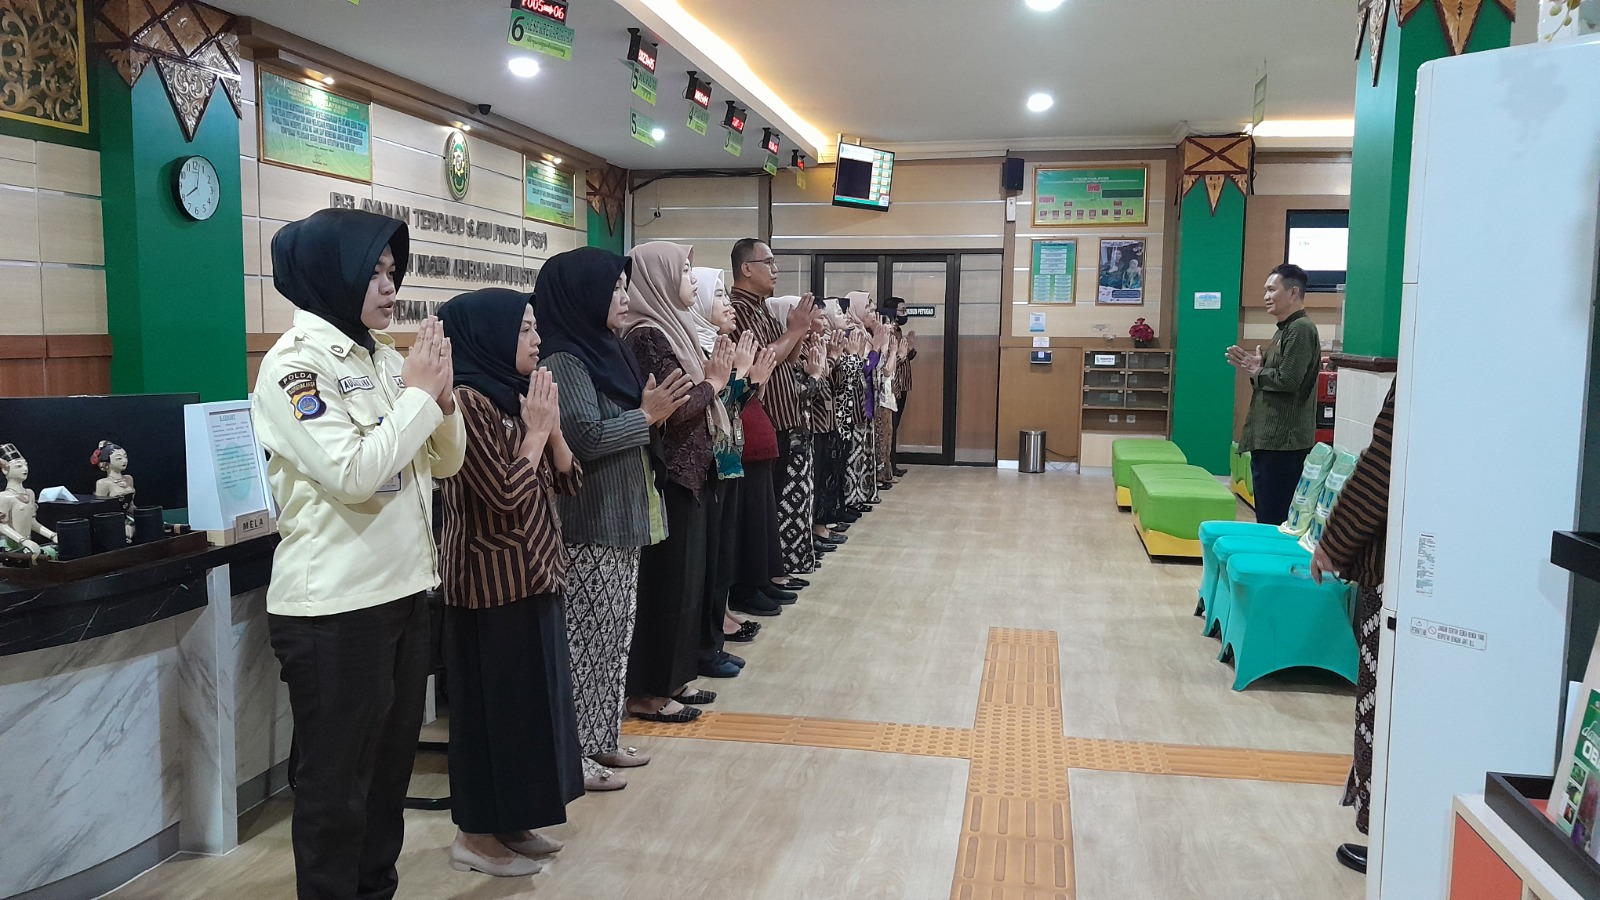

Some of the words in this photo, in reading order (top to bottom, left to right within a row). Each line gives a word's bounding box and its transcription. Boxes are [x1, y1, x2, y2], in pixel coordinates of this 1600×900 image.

[553, 5, 565, 19] 06
[511, 16, 525, 42] 6
[632, 68, 640, 90] 5
[631, 112, 637, 135] 5
[412, 208, 465, 236] TERPADU
[283, 371, 313, 385] POLDA
[242, 518, 264, 531] MELA
